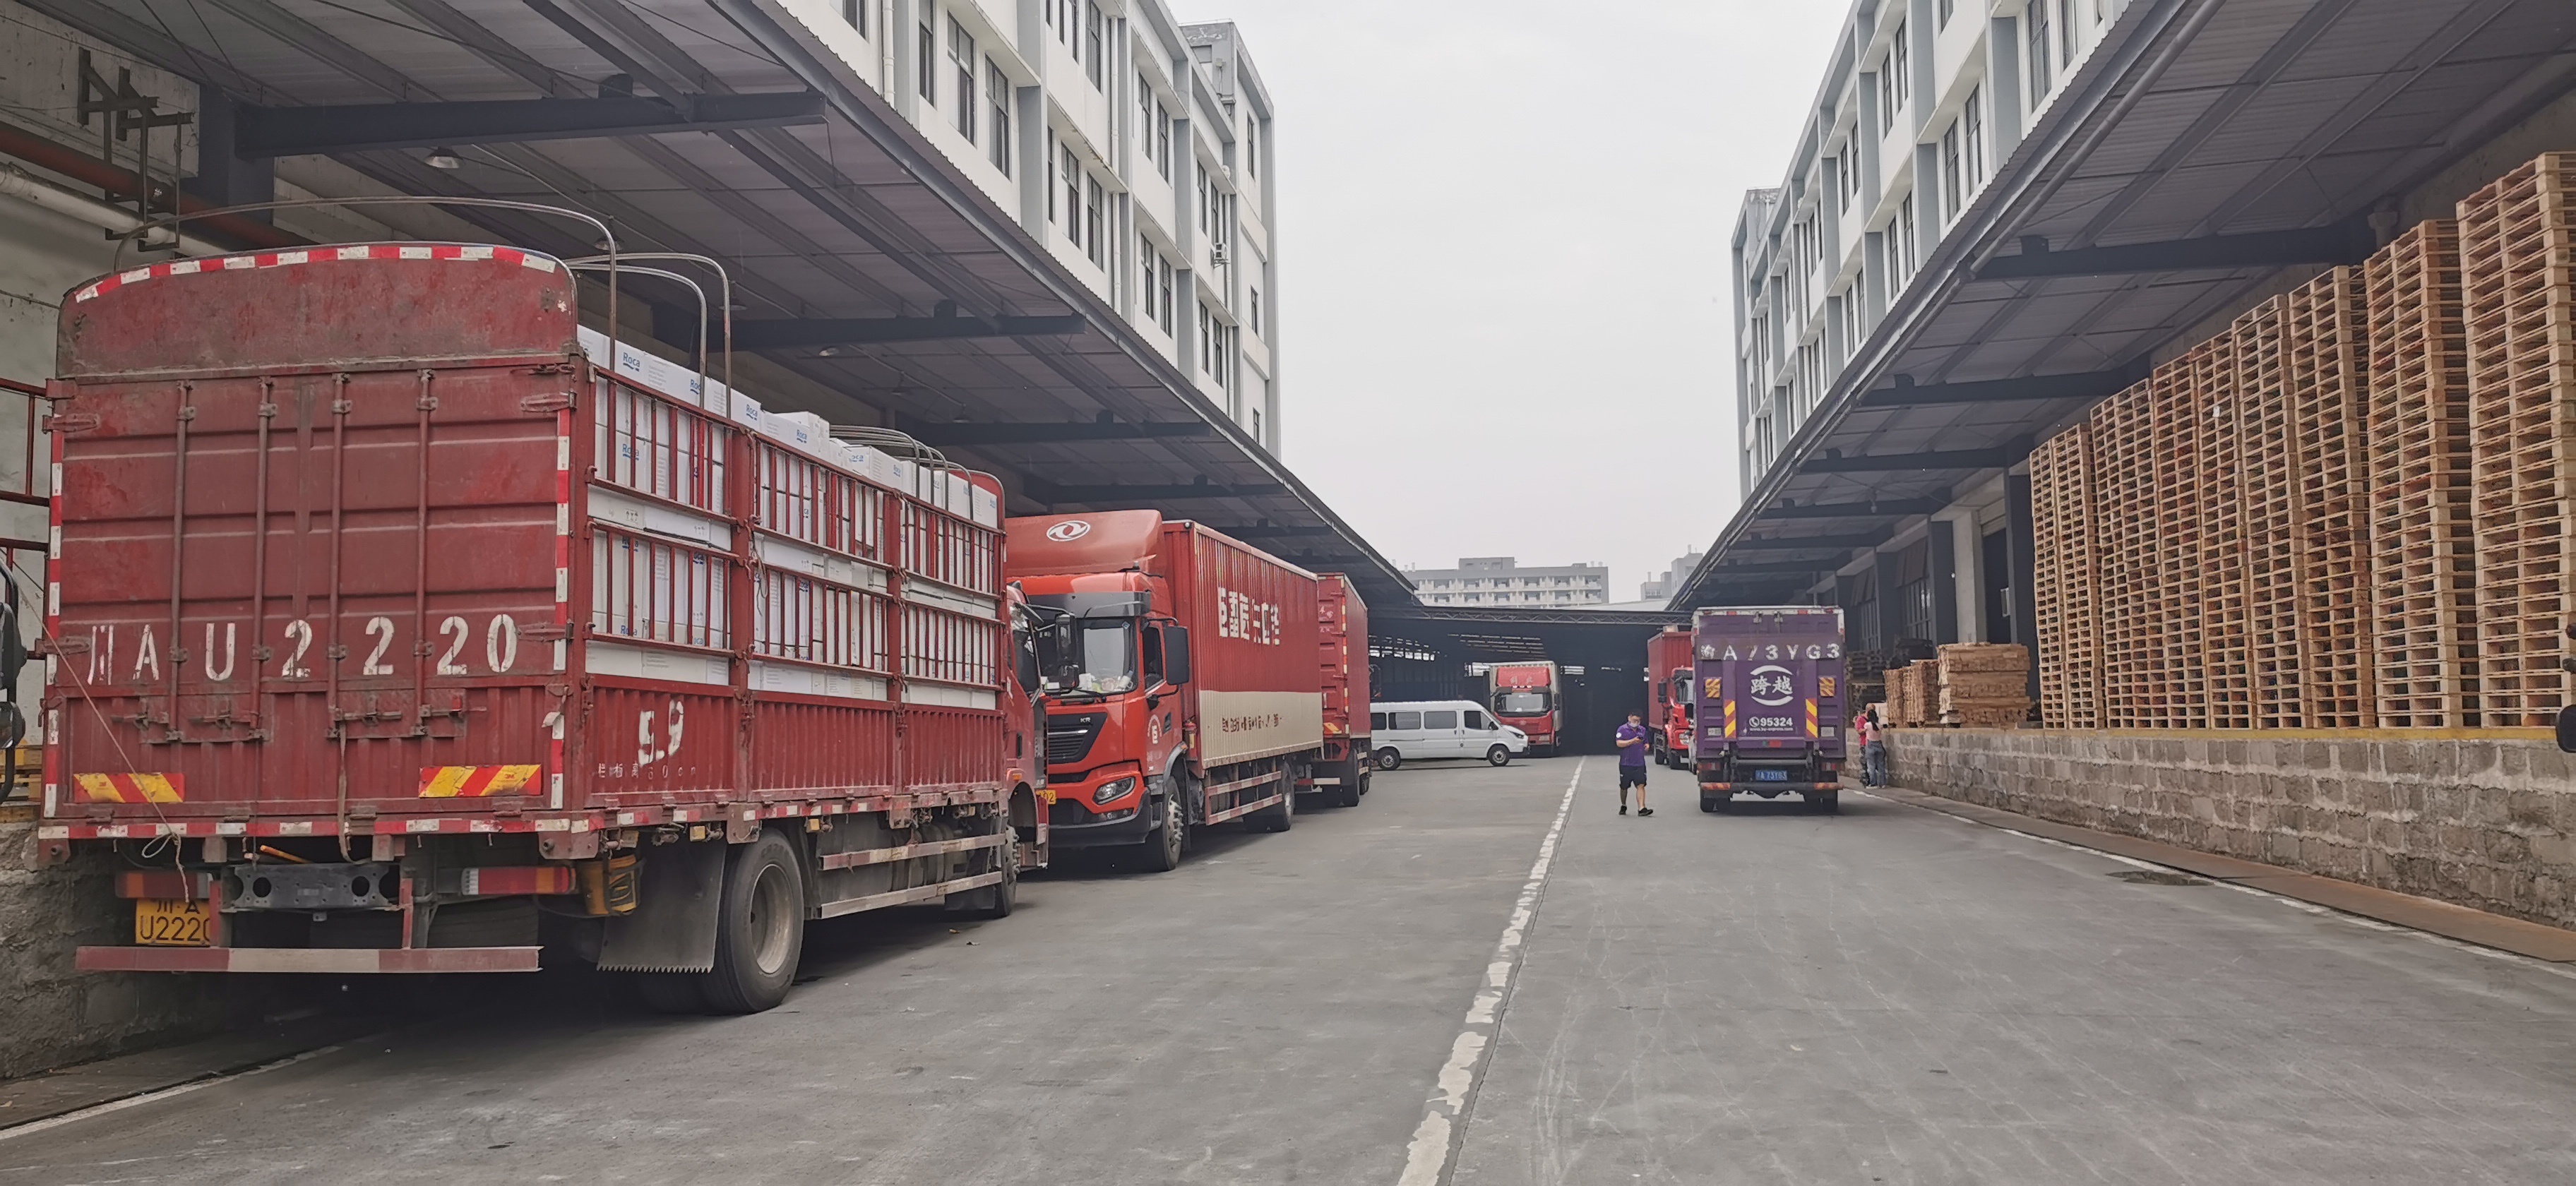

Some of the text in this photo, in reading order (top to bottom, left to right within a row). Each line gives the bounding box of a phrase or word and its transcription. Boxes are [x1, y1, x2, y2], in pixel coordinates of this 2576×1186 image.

[623, 352, 640, 367] Roca
[690, 378, 700, 390] Roc
[746, 404, 758, 417] Roca
[796, 429, 807, 441] Roca
[622, 443, 640, 457] Roa
[620, 625, 638, 636] Roa
[1751, 676, 1794, 695] 跨越
[1760, 717, 1794, 727] 95324
